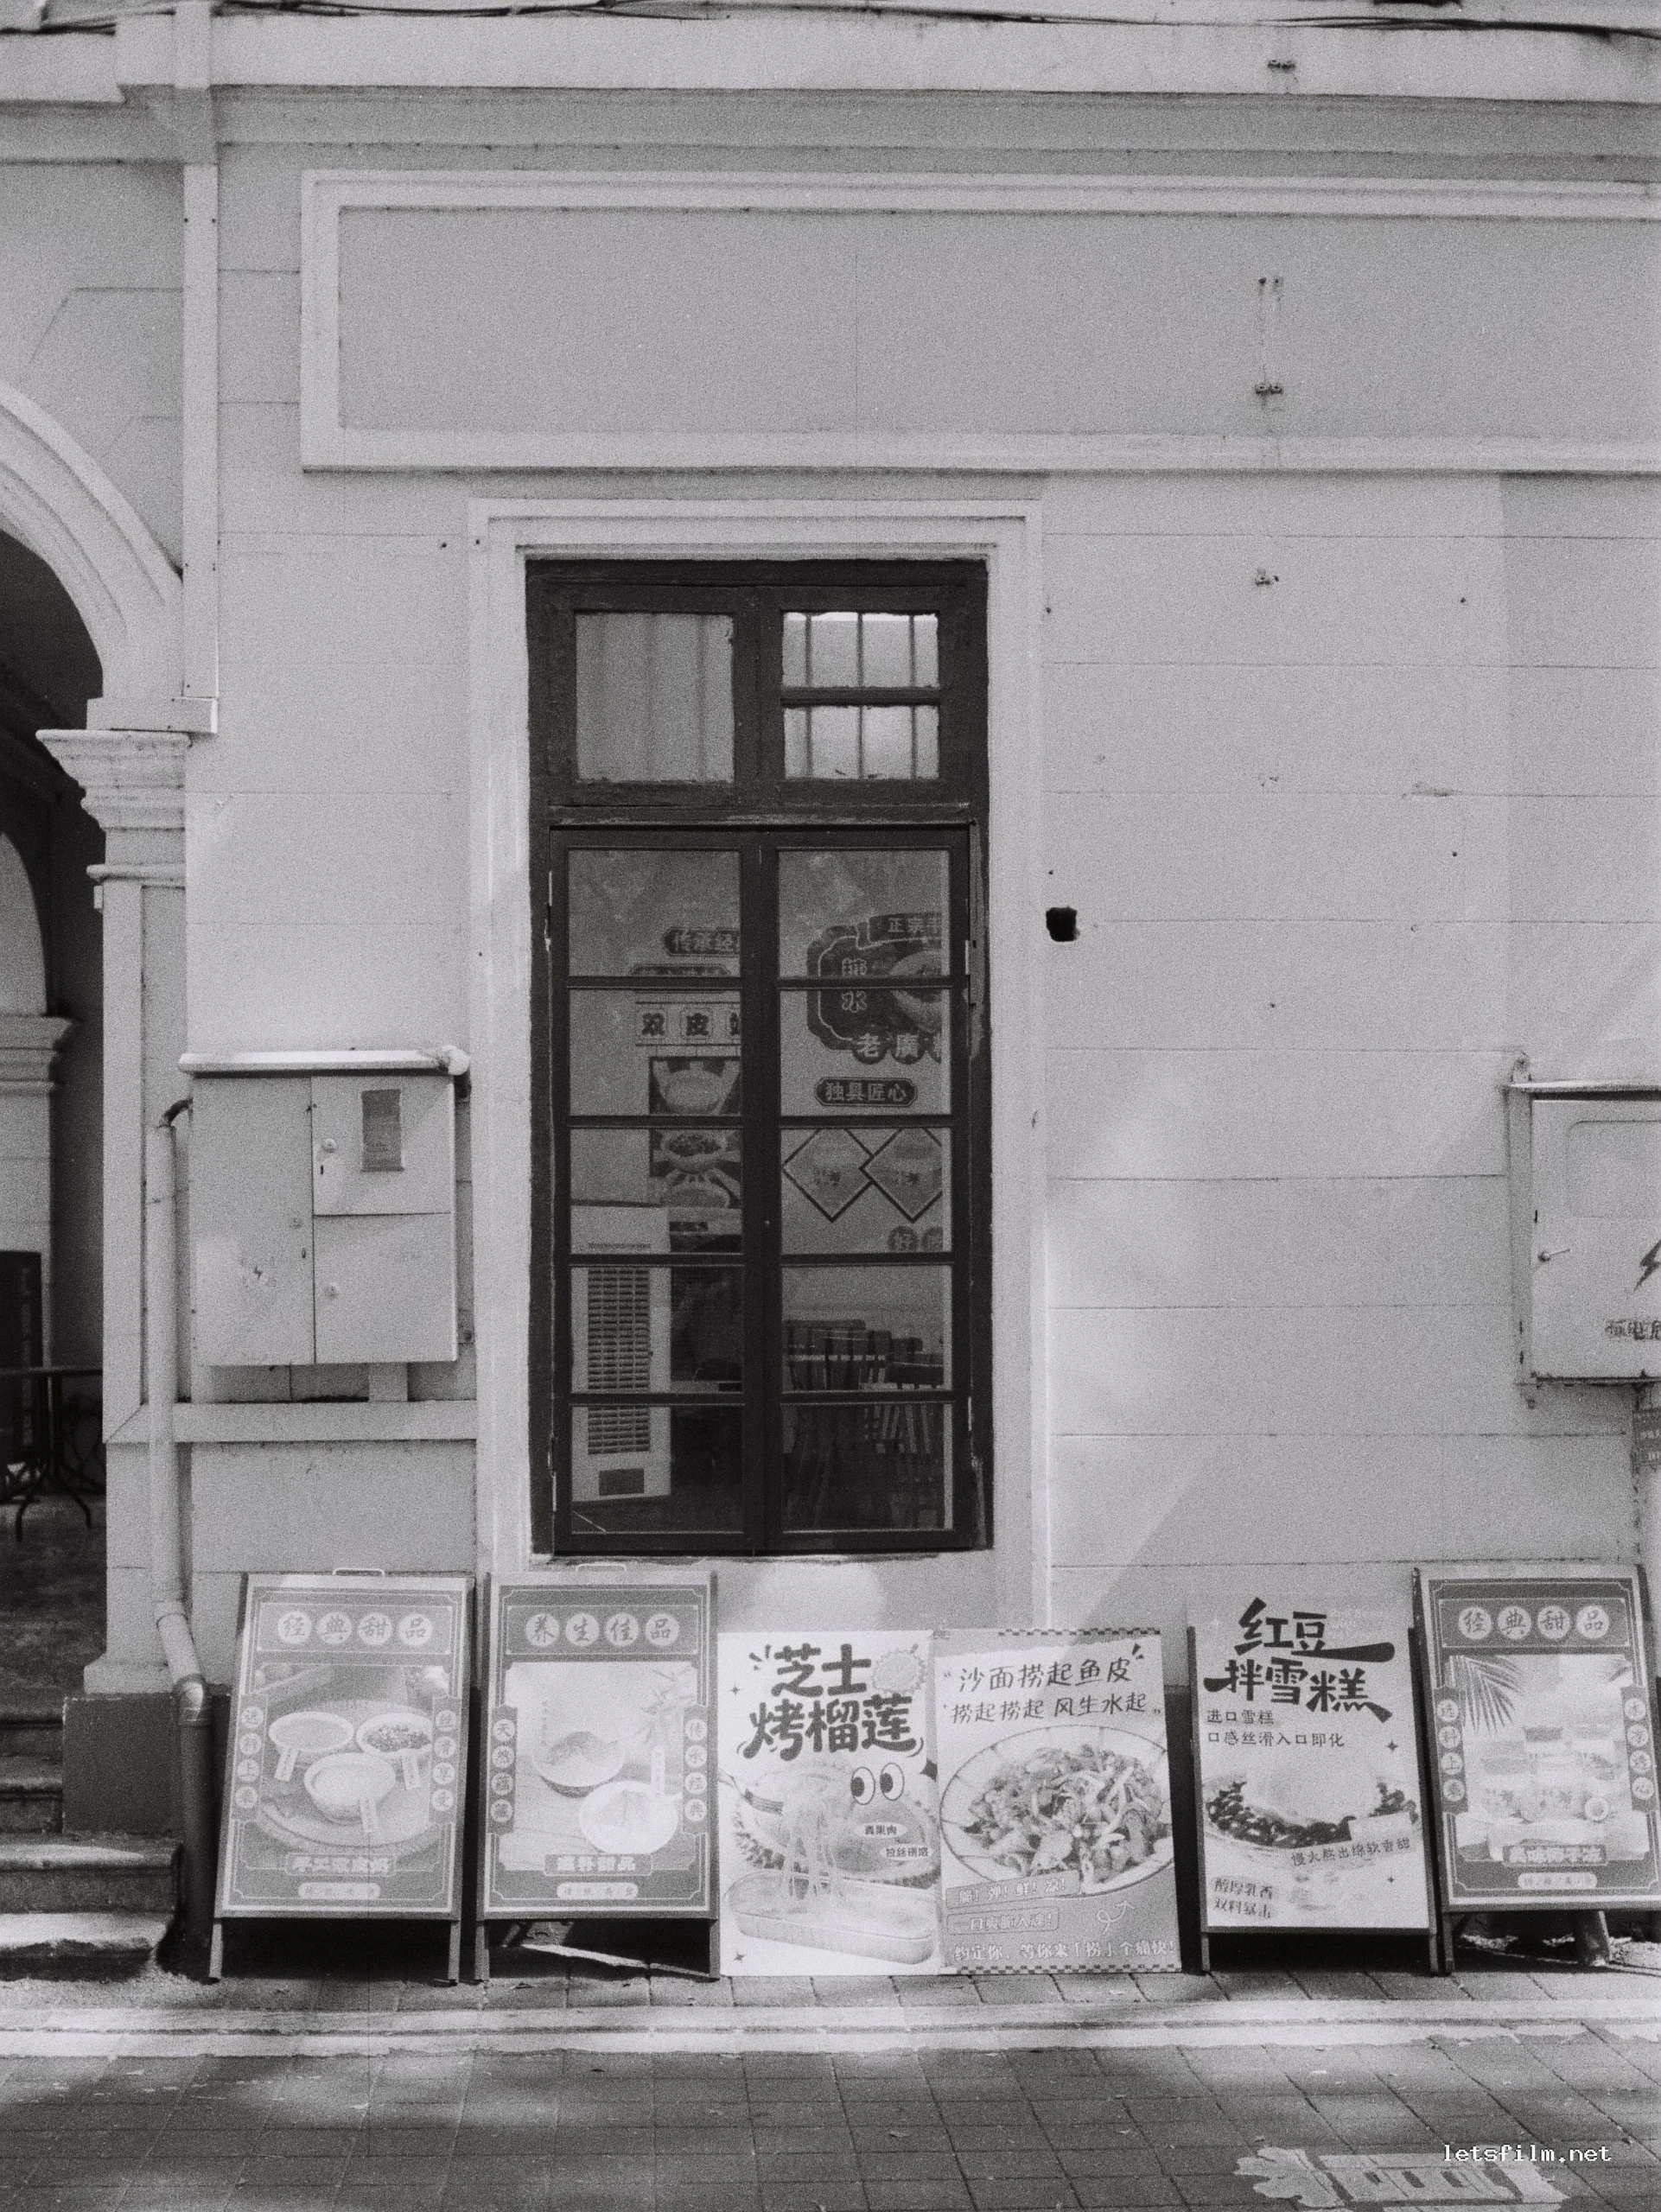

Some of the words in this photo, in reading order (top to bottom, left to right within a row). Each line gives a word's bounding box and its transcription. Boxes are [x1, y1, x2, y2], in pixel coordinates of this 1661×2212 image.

[672, 931, 741, 952] 传承经
[825, 1082, 907, 1103] 独具匠心
[283, 1613, 427, 1641] 经典甜品
[531, 1614, 671, 1643] 养生佳品
[1234, 1597, 1395, 1663] 红豆
[1462, 1609, 1604, 1636] 经典甜品
[771, 1643, 871, 1697] 芝士
[1203, 1656, 1393, 1723] 拌雪糕
[743, 1693, 917, 1761] 烤榴莲
[1206, 1709, 1275, 1726] 进口雪糕
[1207, 1732, 1345, 1746] 口感丝滑入口即化
[687, 1721, 705, 1818] 传承经典
[865, 1824, 897, 1835] 真果肉
[1291, 1837, 1410, 1866] 慢火熬出绵软香甜
